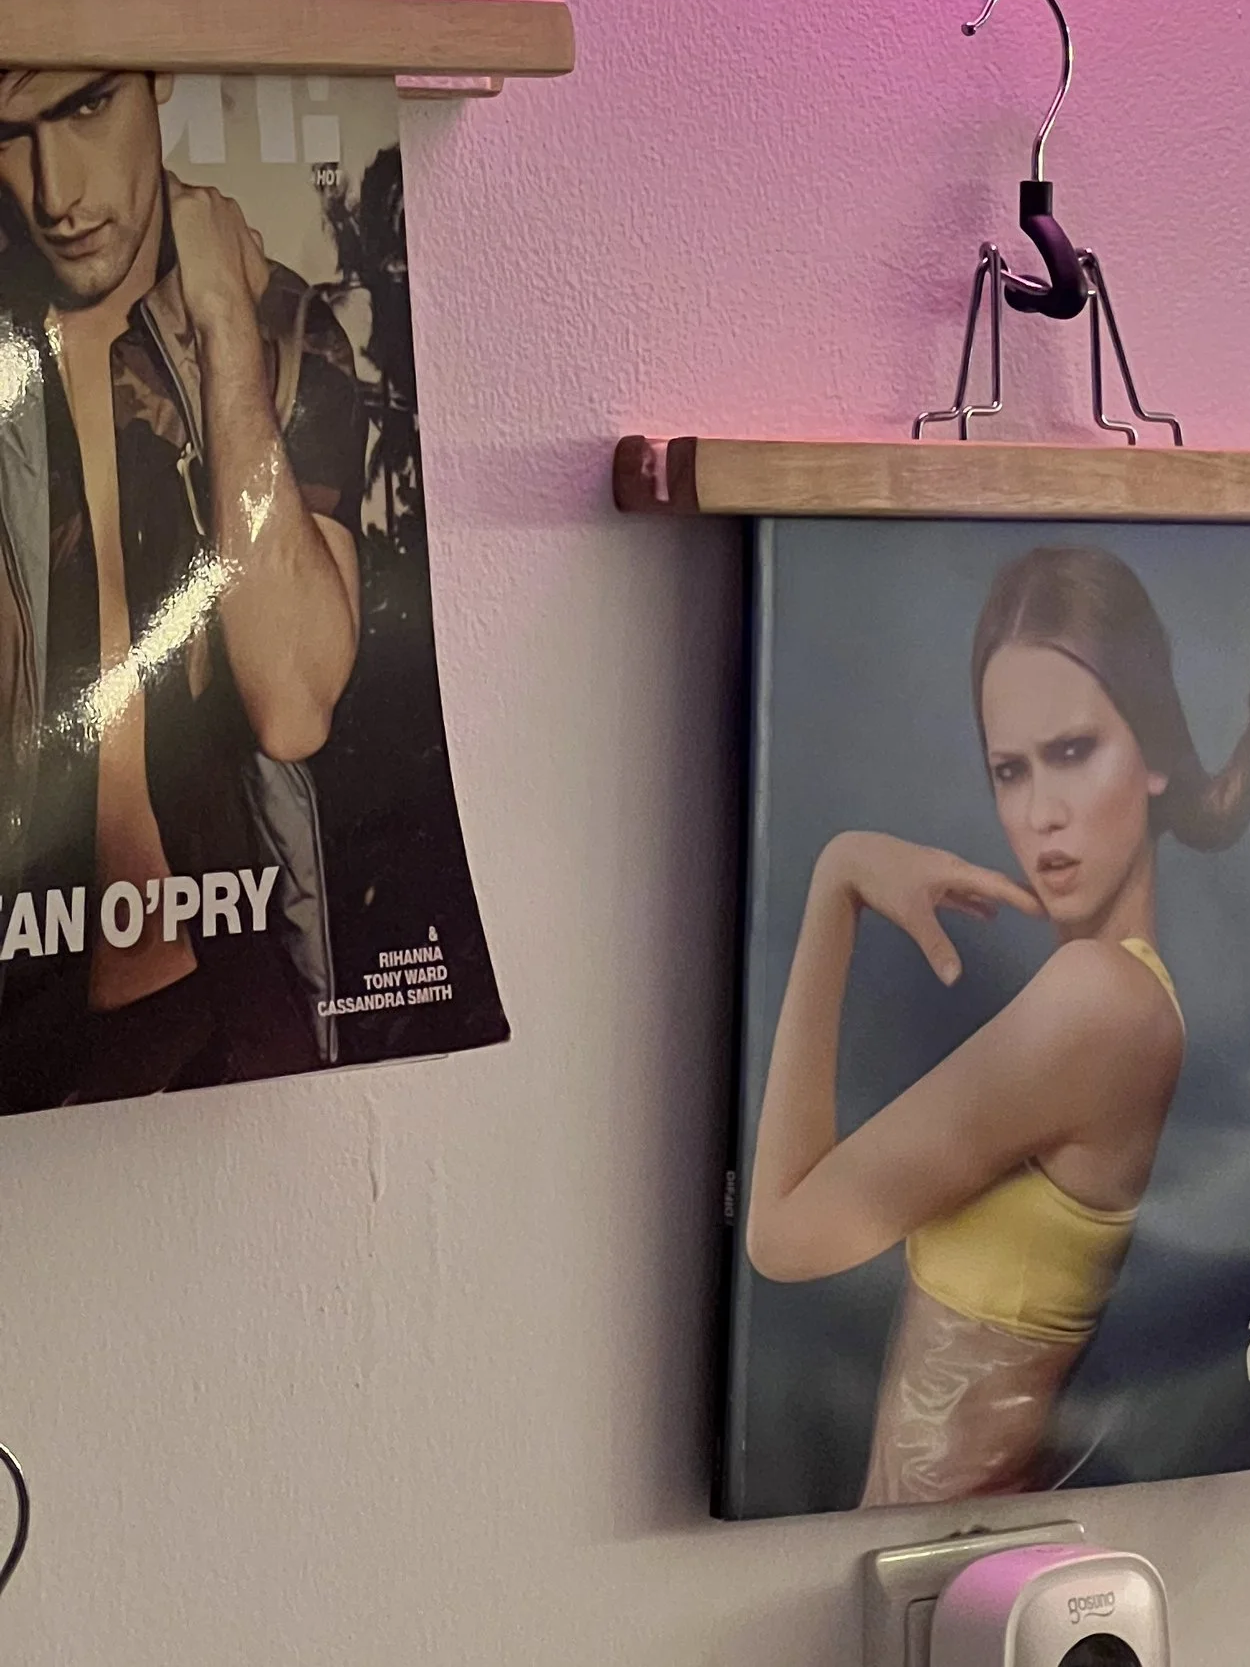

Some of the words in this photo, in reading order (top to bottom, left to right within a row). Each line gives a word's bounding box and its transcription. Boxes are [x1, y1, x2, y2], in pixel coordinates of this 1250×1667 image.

[0, 886, 87, 961] AN
[99, 865, 280, 949] O'PRY
[428, 926, 439, 942] &
[378, 946, 444, 969] RIHANNA
[364, 970, 403, 991] TONY
[404, 964, 448, 987] WARD
[317, 991, 406, 1018] CASSANDRA
[407, 984, 453, 1006] SMITH
